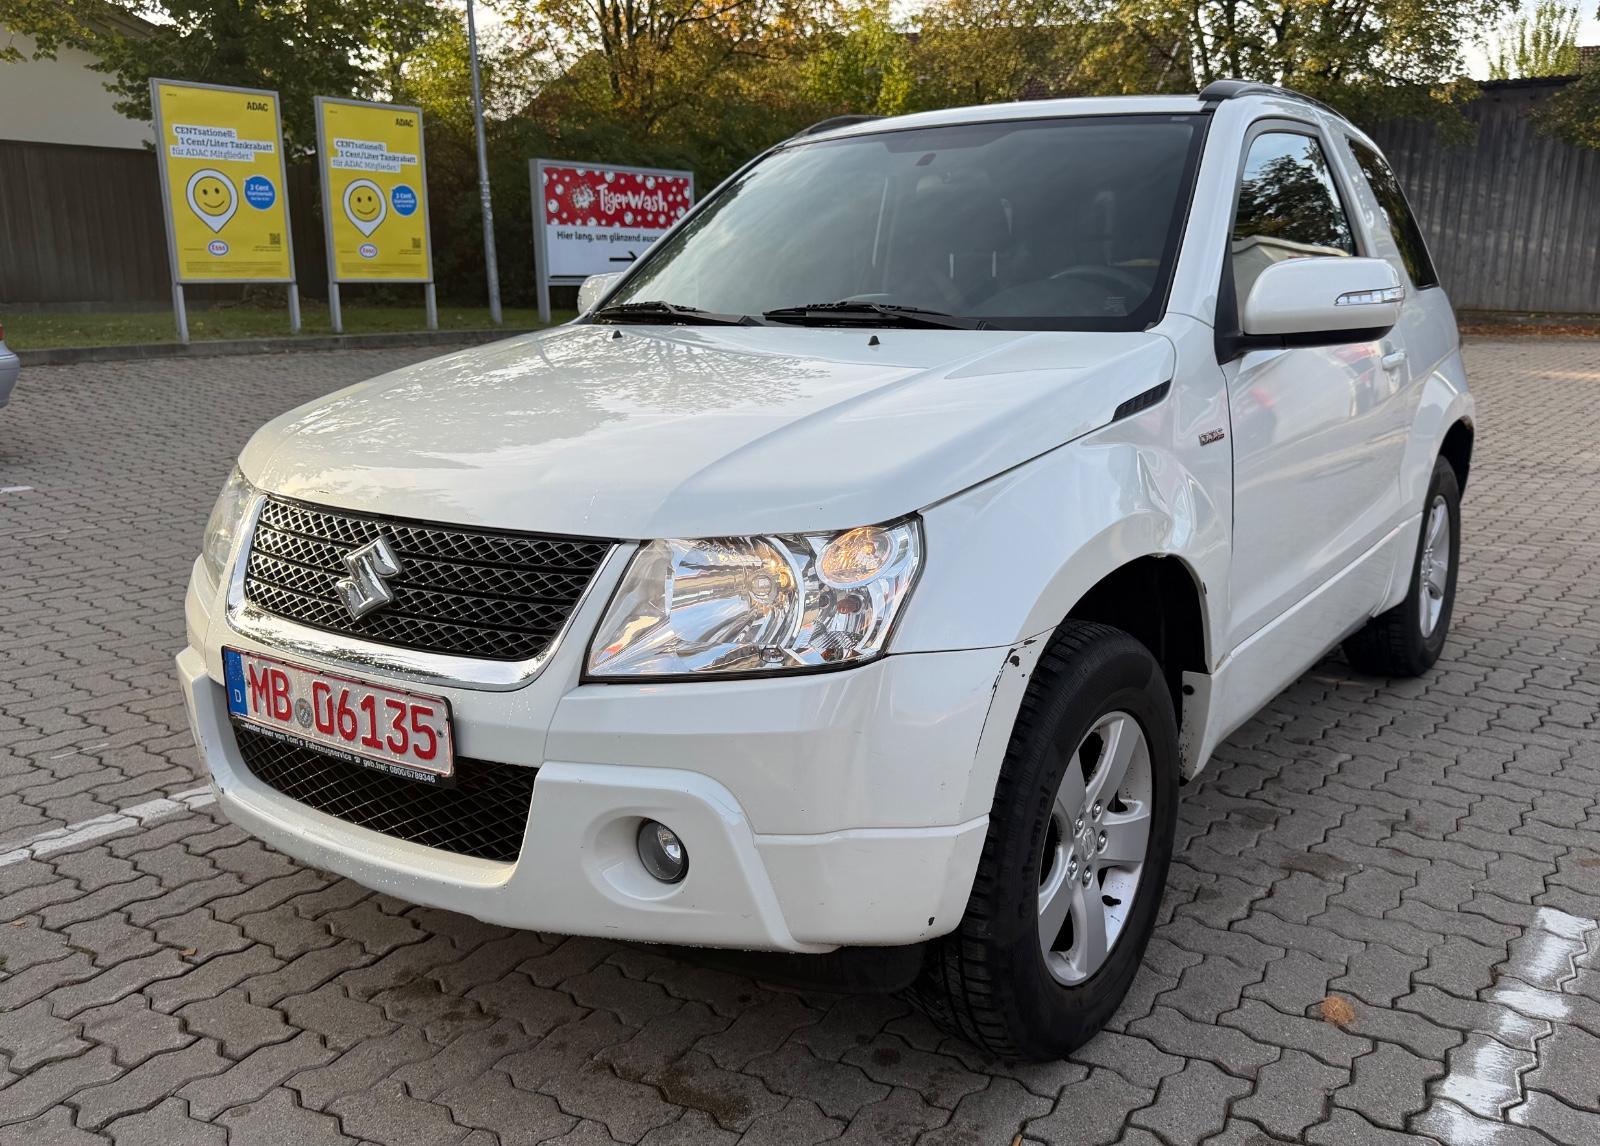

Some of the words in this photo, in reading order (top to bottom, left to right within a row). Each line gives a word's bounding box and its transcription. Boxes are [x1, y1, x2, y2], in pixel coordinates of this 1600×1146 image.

[246, 101, 269, 112] ADAC
[395, 118, 414, 128] ADAC
[186, 138, 229, 148] Cent/Liter
[230, 141, 273, 151] Tankrabatt
[172, 146, 184, 155] für
[185, 148, 208, 157] ADAC
[344, 160, 363, 168] ADAC
[596, 183, 668, 216] TigerWash
[557, 231, 573, 240] Hier
[575, 231, 595, 243] lang,
[596, 233, 608, 241] um
[609, 232, 641, 244] glänzend
[211, 243, 226, 252] Esso
[234, 688, 242, 703] D
[248, 663, 293, 722] MB
[311, 679, 438, 760] 06135
